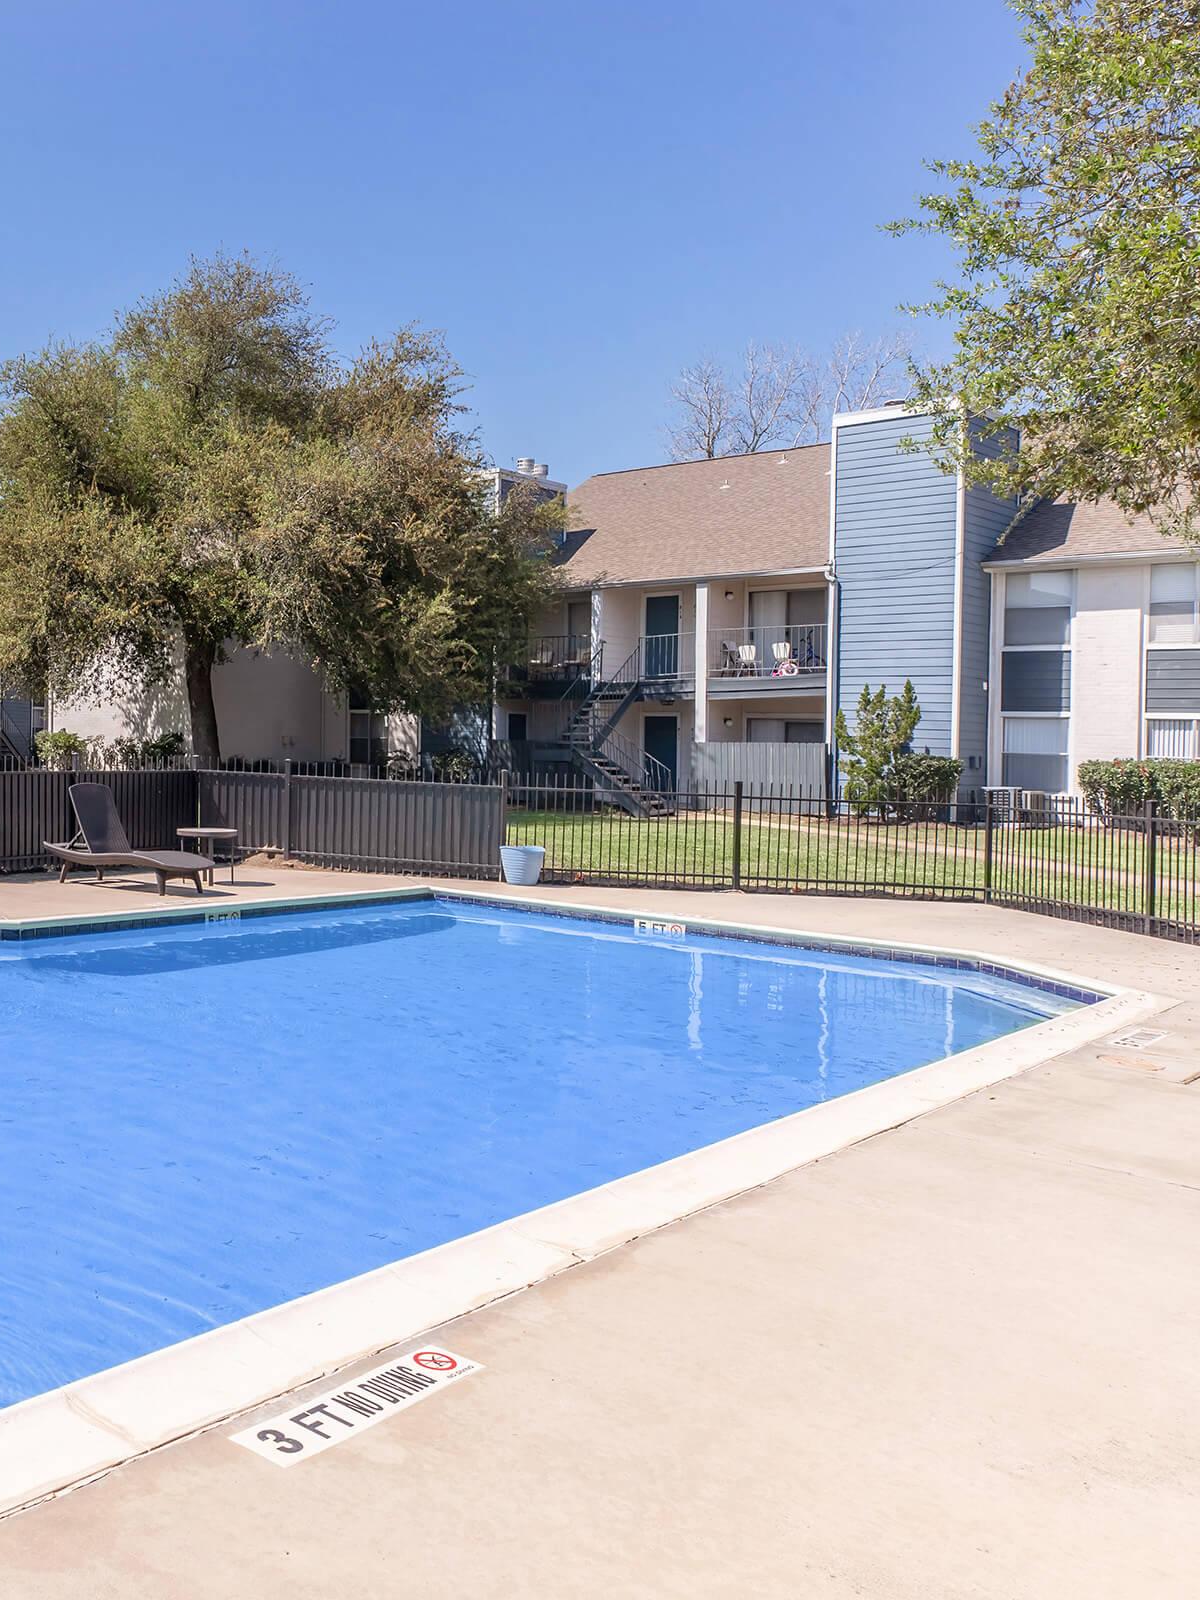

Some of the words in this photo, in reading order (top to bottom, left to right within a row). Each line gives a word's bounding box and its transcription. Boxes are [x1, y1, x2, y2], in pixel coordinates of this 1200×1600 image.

[357, 1365, 438, 1404] DIVING
[331, 1391, 384, 1418] NO
[289, 1403, 354, 1440] FT
[257, 1429, 304, 1454] 3
